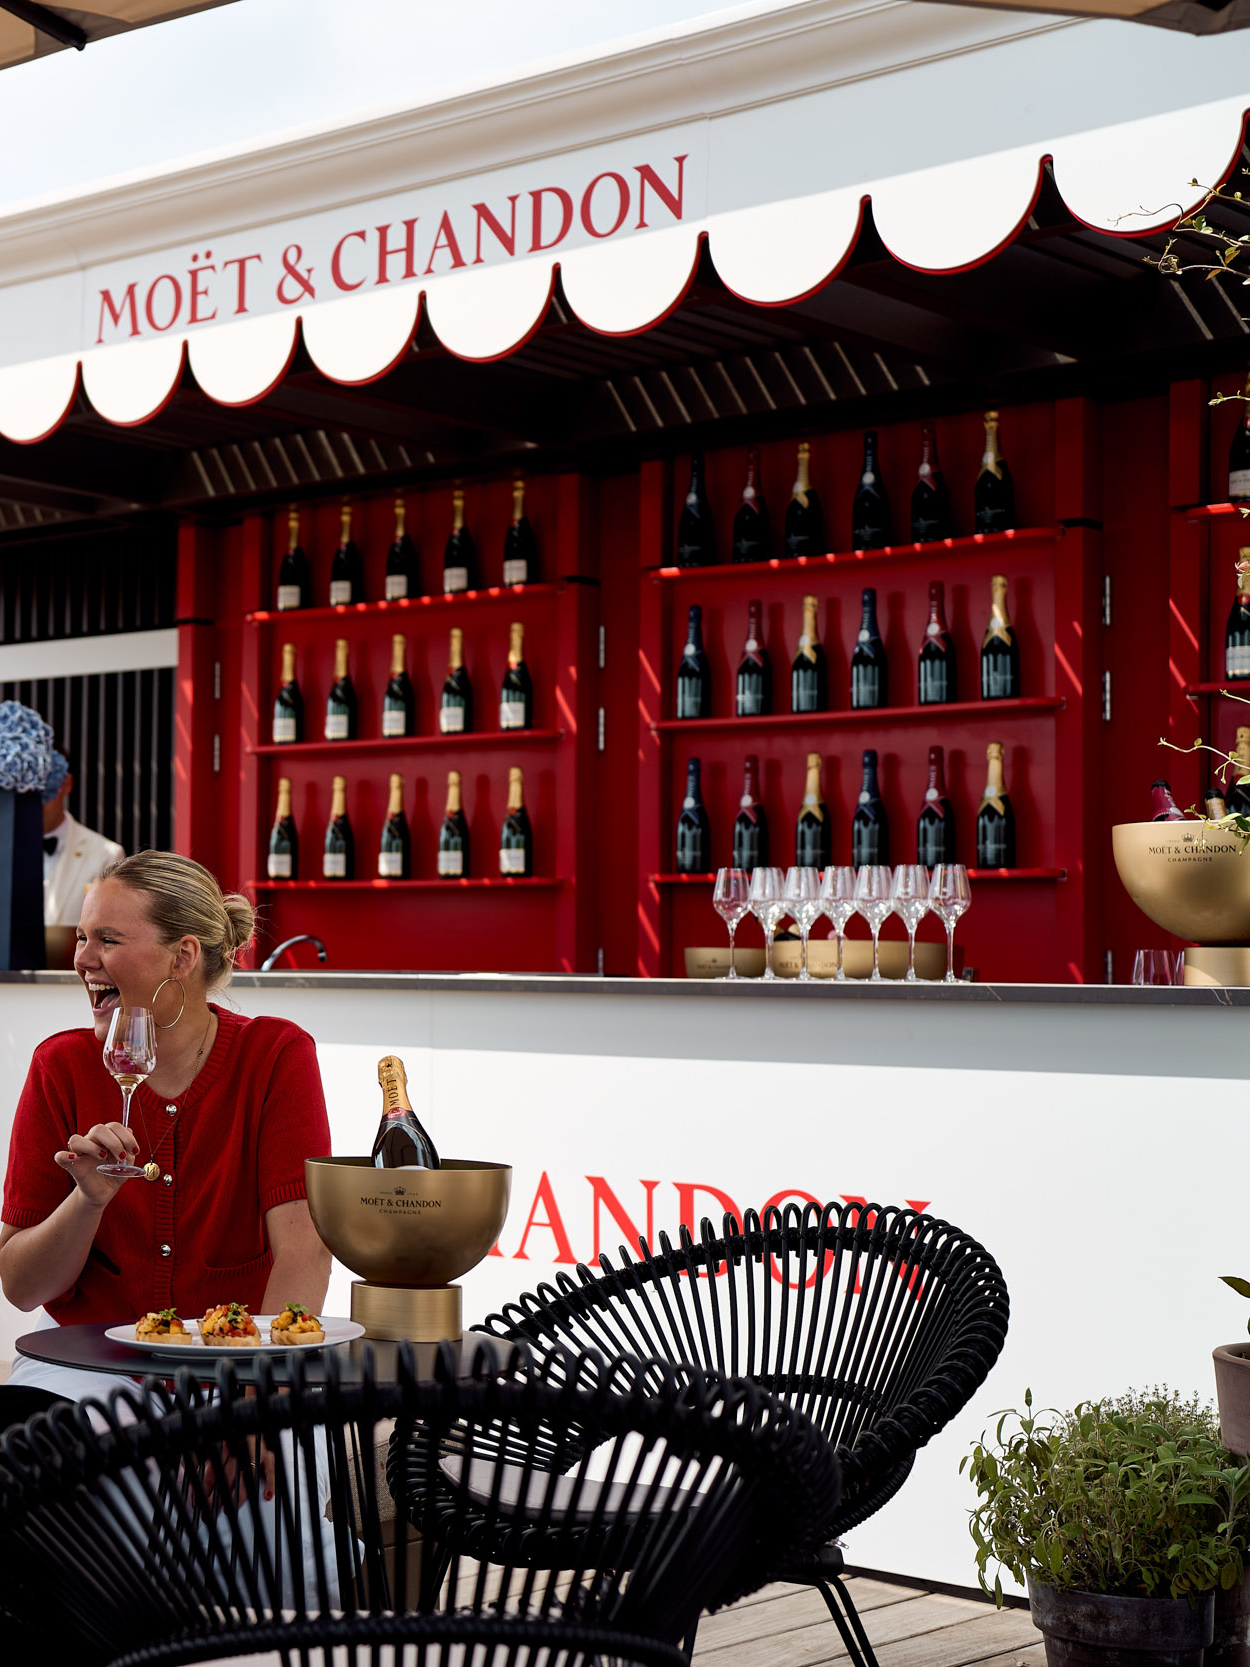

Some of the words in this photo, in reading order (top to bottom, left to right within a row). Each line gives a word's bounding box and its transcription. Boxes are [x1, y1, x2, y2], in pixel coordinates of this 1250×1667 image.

[95, 250, 262, 344] MOËT
[276, 244, 316, 305] &
[331, 154, 689, 291] CHANDON
[1149, 845, 1171, 855] MOËT
[1174, 846, 1181, 854] &
[1184, 844, 1237, 854] CHANDON
[360, 1196, 385, 1206] MOËT
[387, 1199, 393, 1207] &
[395, 1199, 442, 1208] CHANDON
[486, 1170, 931, 1301] ANDON
